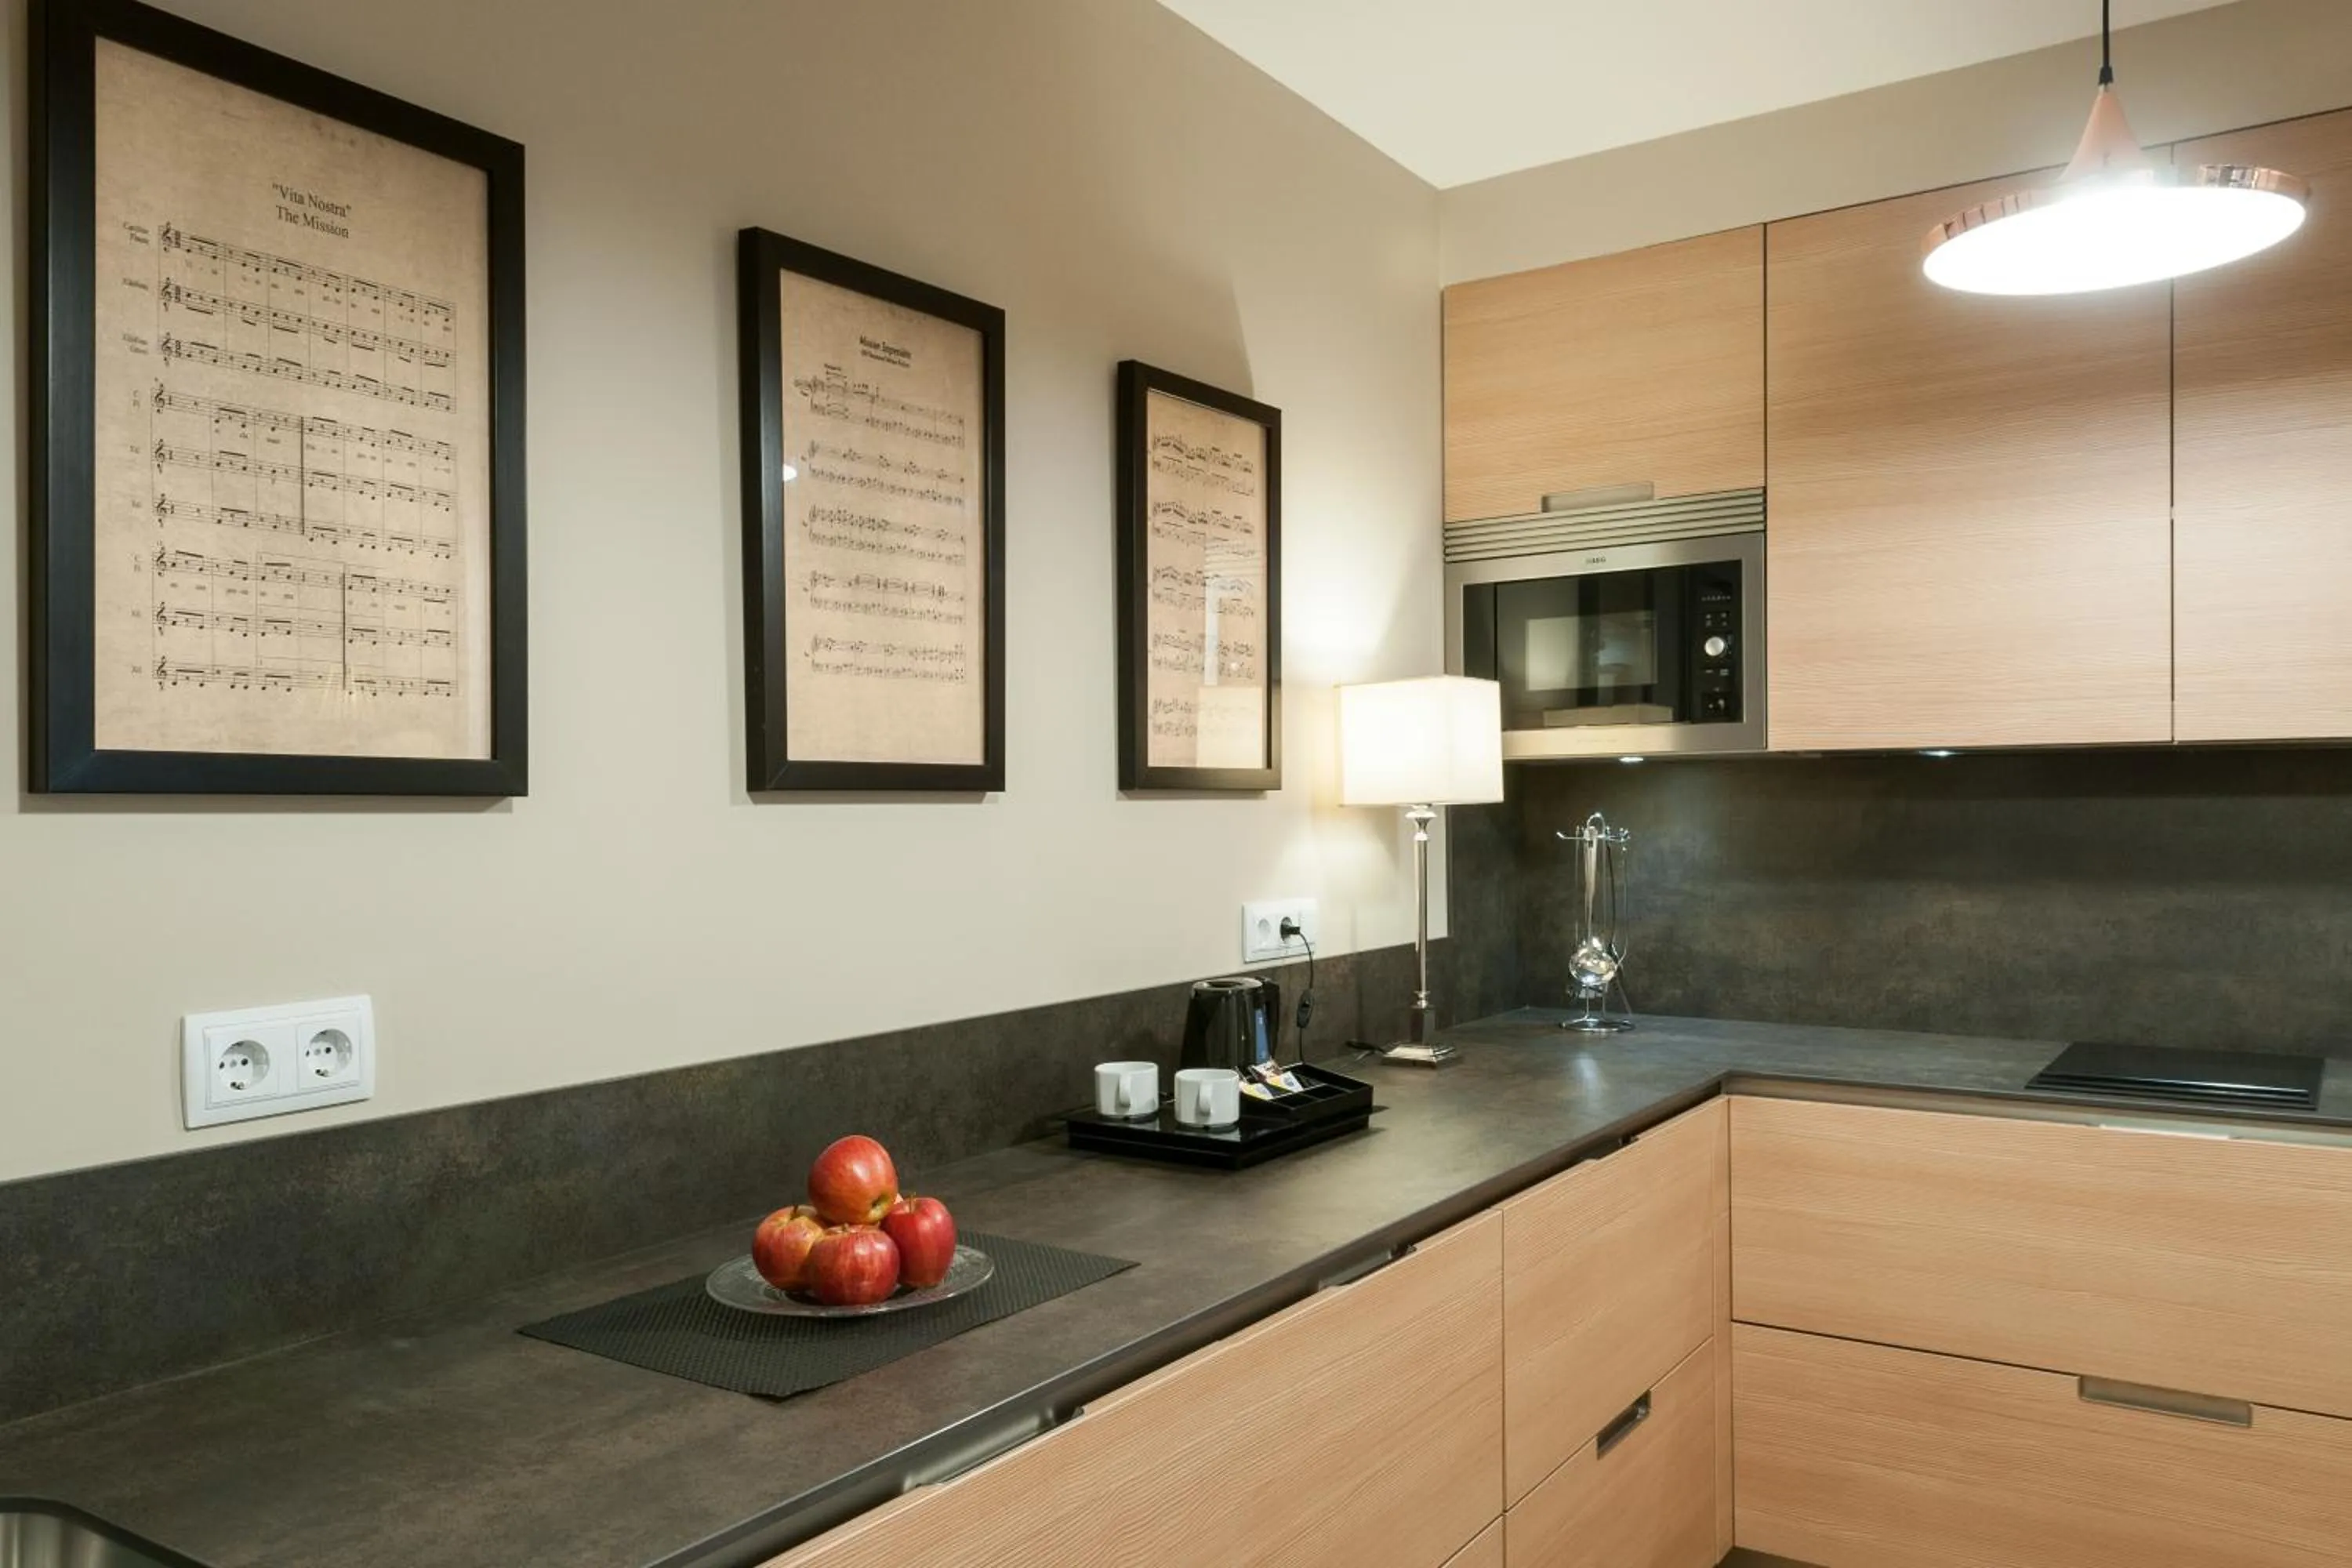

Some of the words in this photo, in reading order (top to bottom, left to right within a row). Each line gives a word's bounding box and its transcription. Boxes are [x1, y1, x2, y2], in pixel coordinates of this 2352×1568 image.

[273, 183, 305, 205] "Vita
[275, 205, 299, 224] The
[303, 213, 349, 238] Mission
